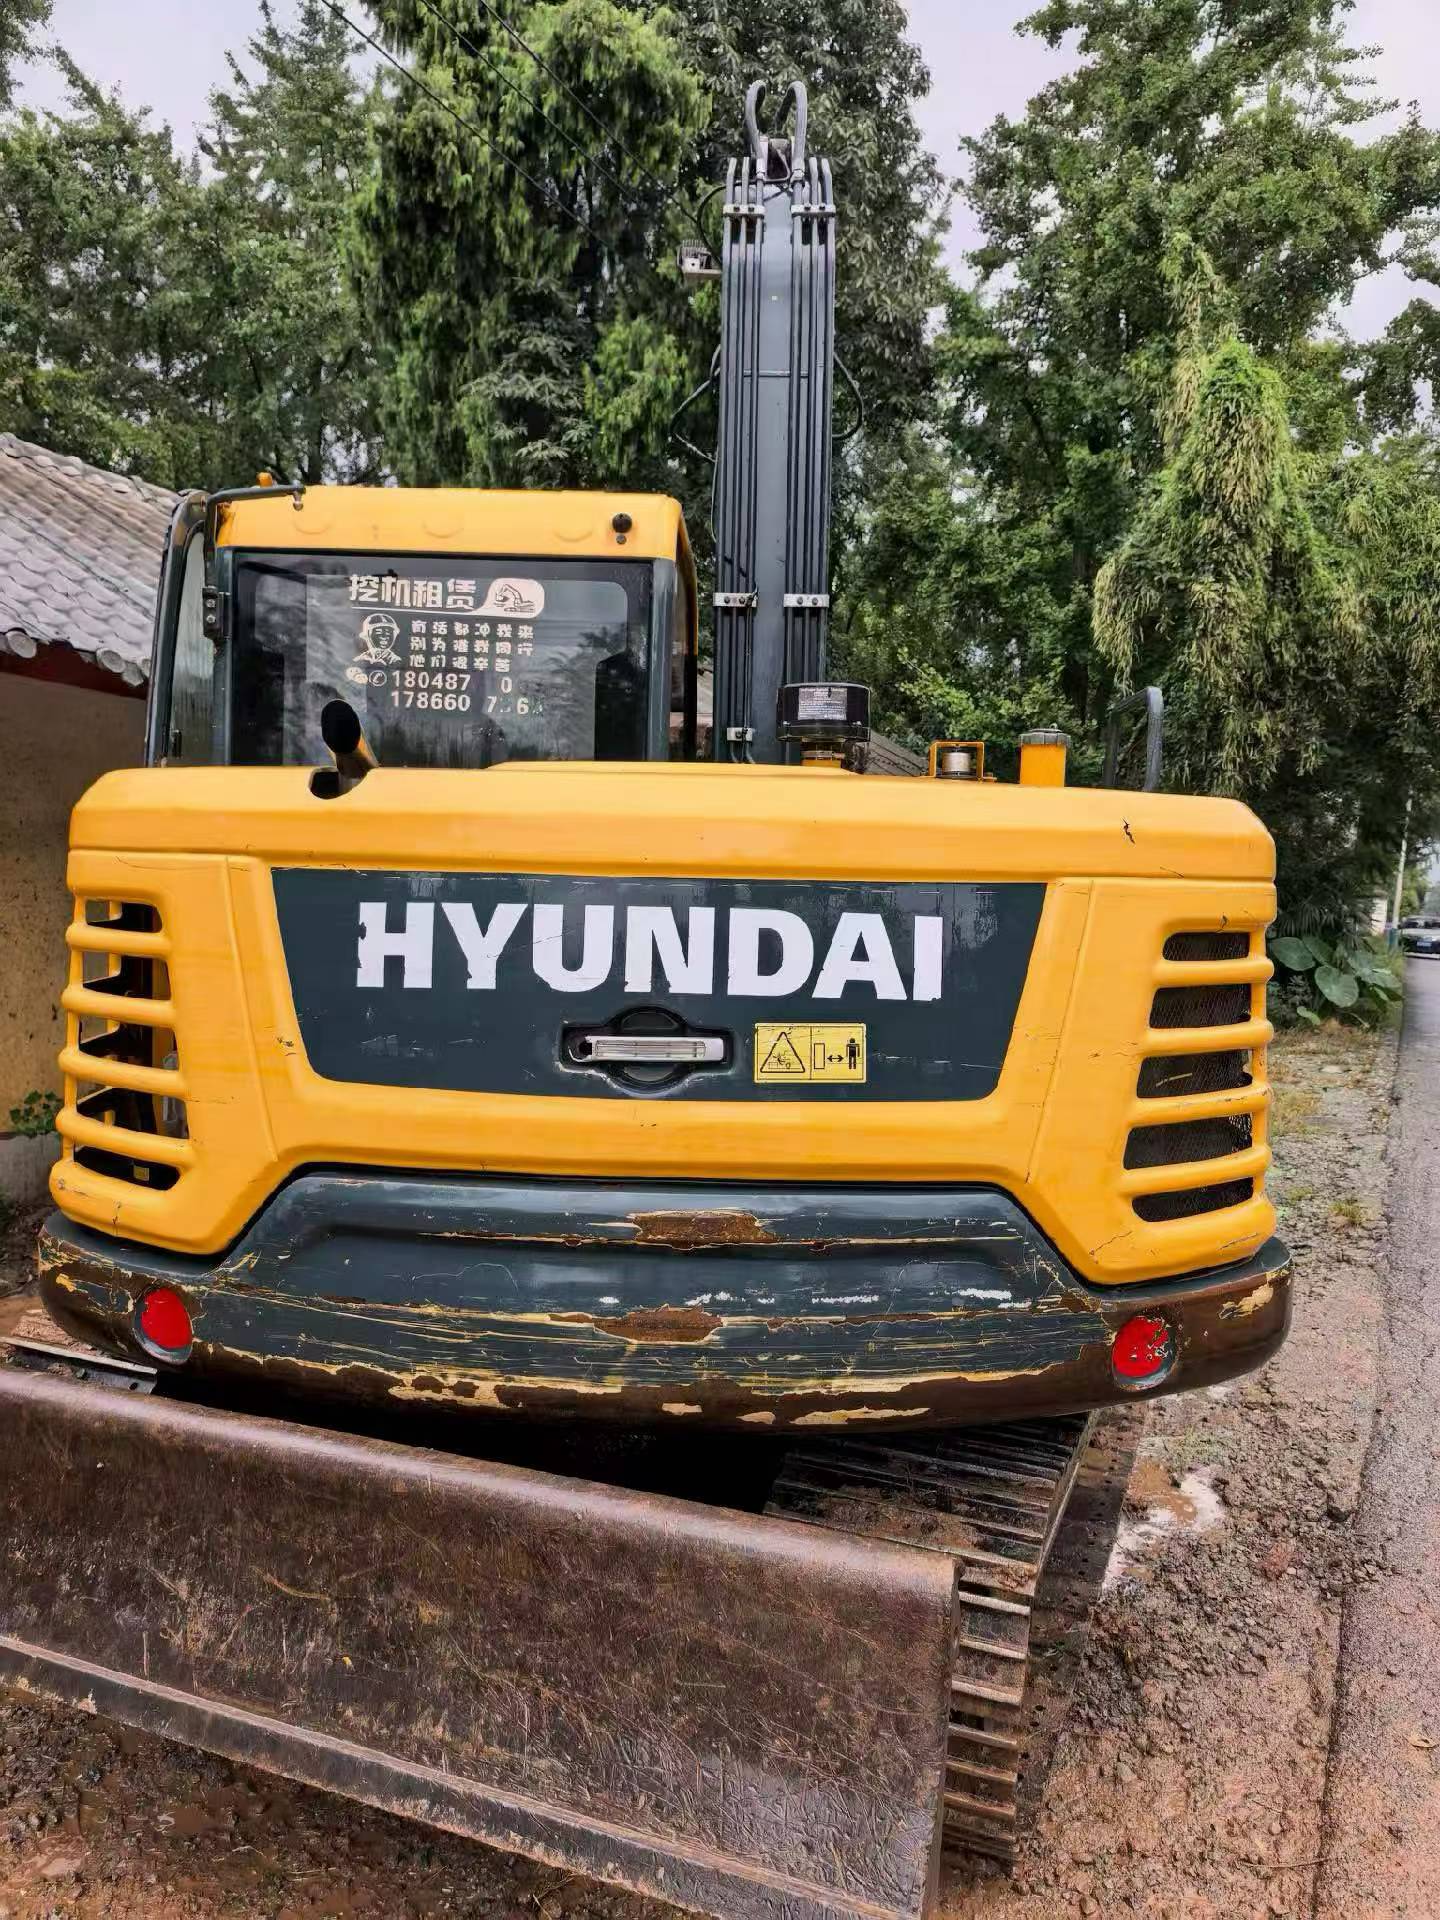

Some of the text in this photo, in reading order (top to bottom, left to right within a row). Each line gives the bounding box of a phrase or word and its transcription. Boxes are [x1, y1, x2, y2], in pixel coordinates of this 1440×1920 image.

[349, 574, 477, 610] 挖机租赁
[356, 901, 944, 1001] HYUNDAI
